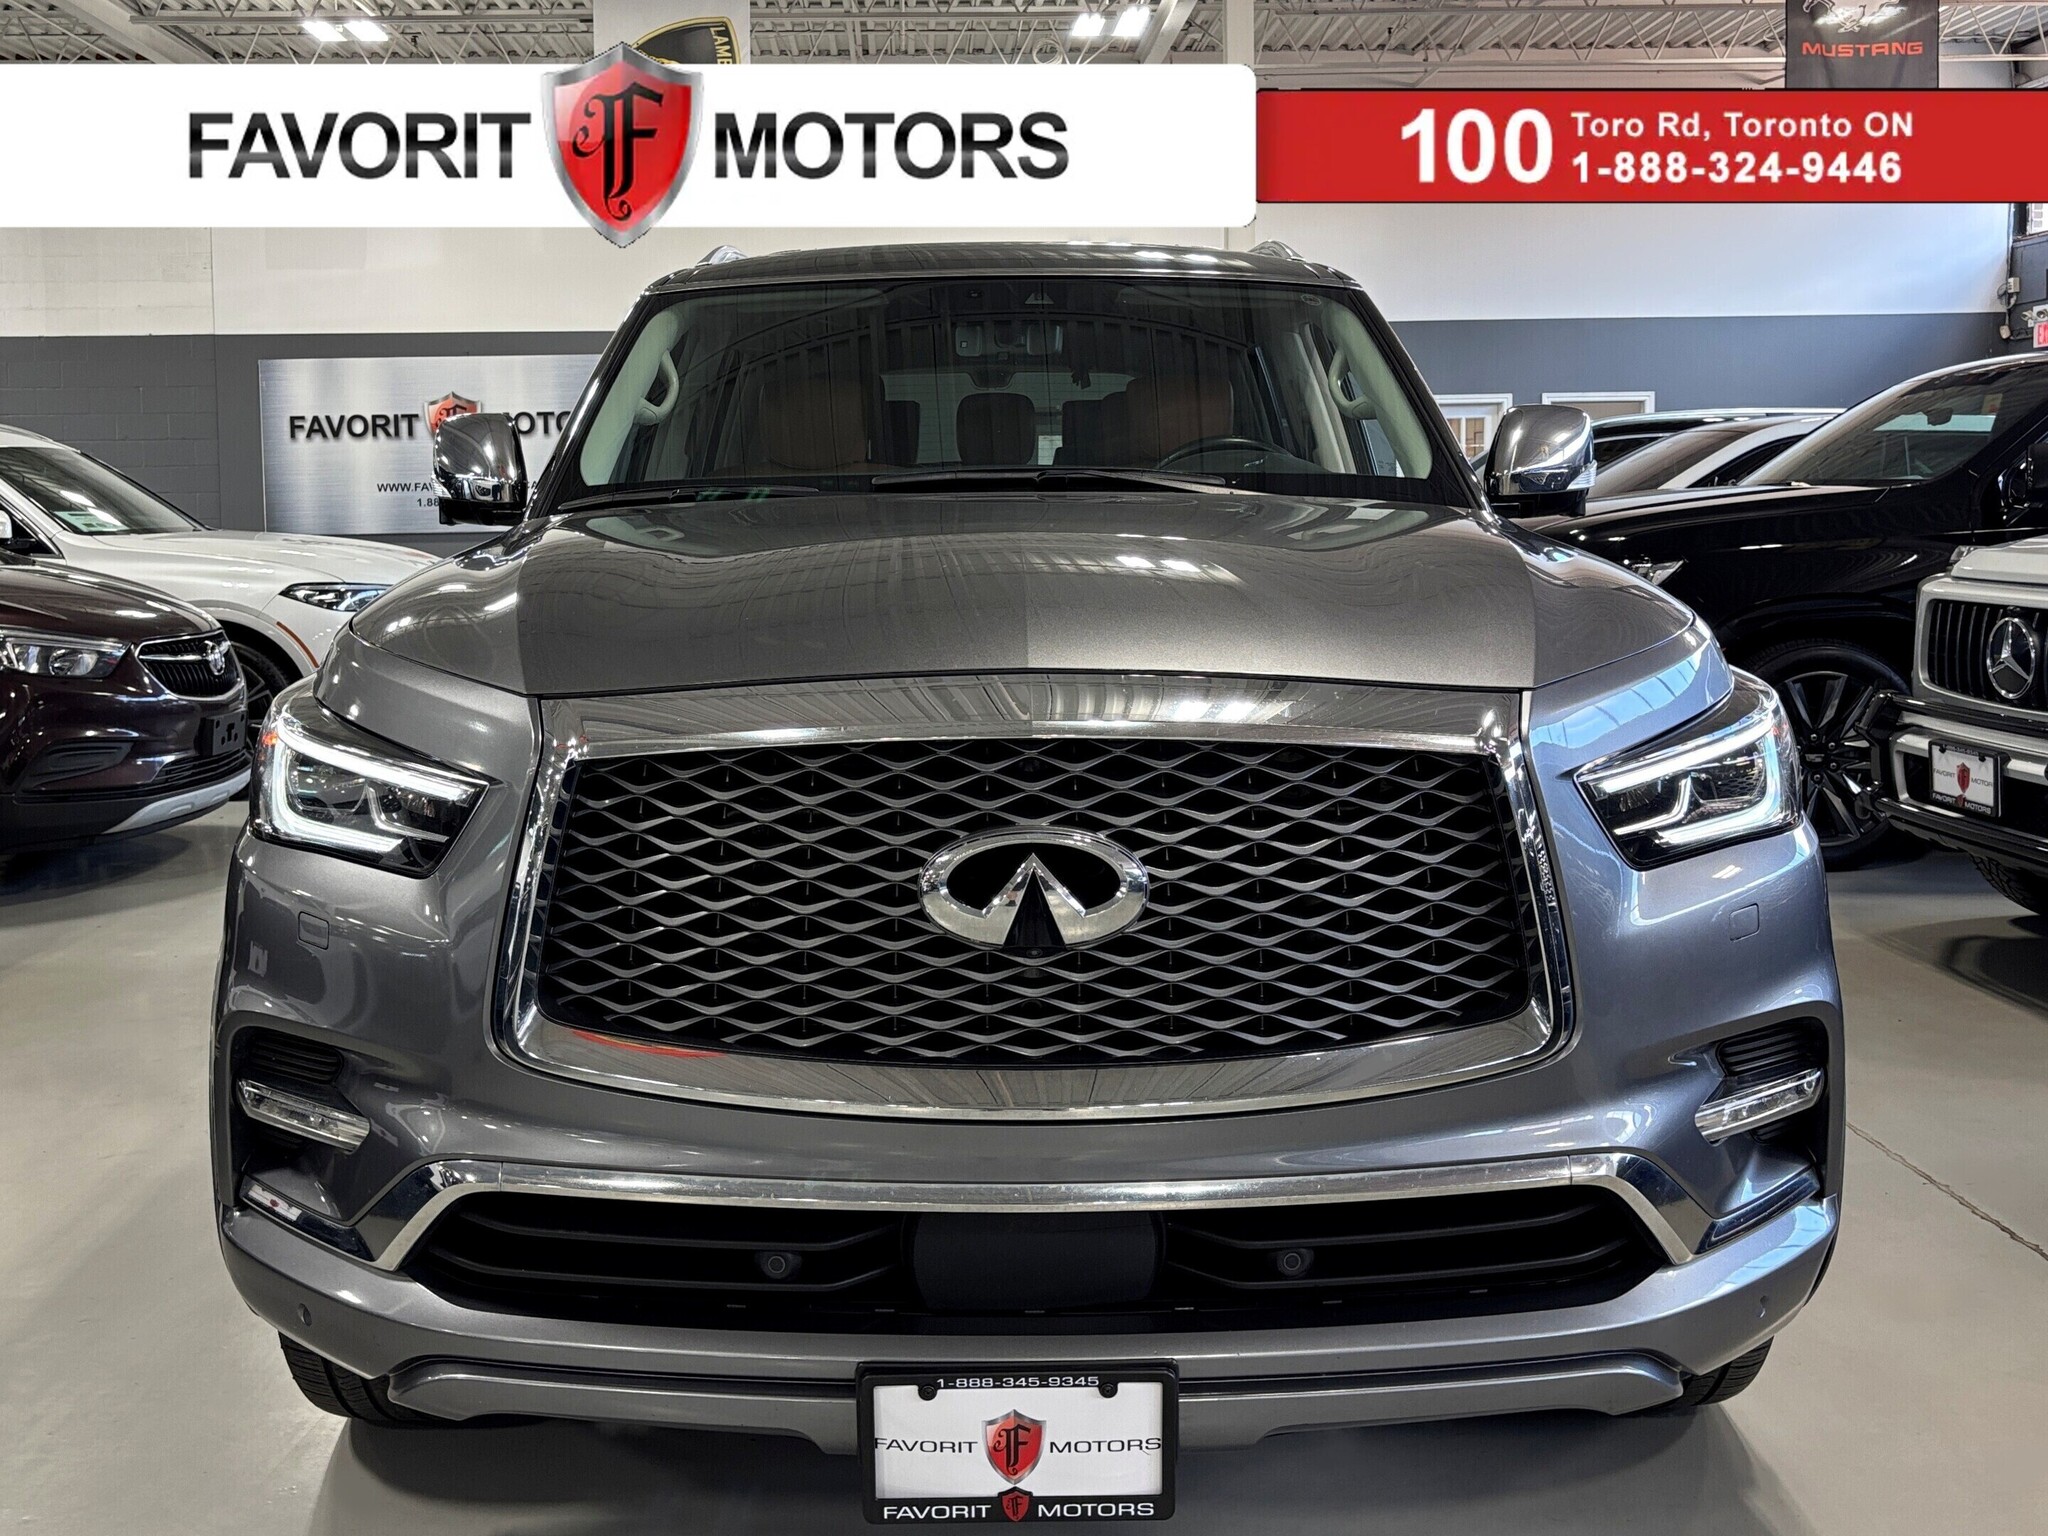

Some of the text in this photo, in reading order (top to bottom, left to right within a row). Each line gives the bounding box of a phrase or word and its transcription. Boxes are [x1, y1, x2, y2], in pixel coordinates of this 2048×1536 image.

[709, 26, 733, 64] LAMB
[1801, 41, 1923, 57] MUSTANG
[289, 413, 419, 440] FAVORIT
[936, 1376, 1099, 1388] 1-888-345-9345
[874, 1437, 978, 1454] FAVORIT
[1049, 1437, 1162, 1454] MOTORS
[883, 1504, 992, 1520] FAVORIT
[1037, 1502, 1154, 1518] MOTORS
